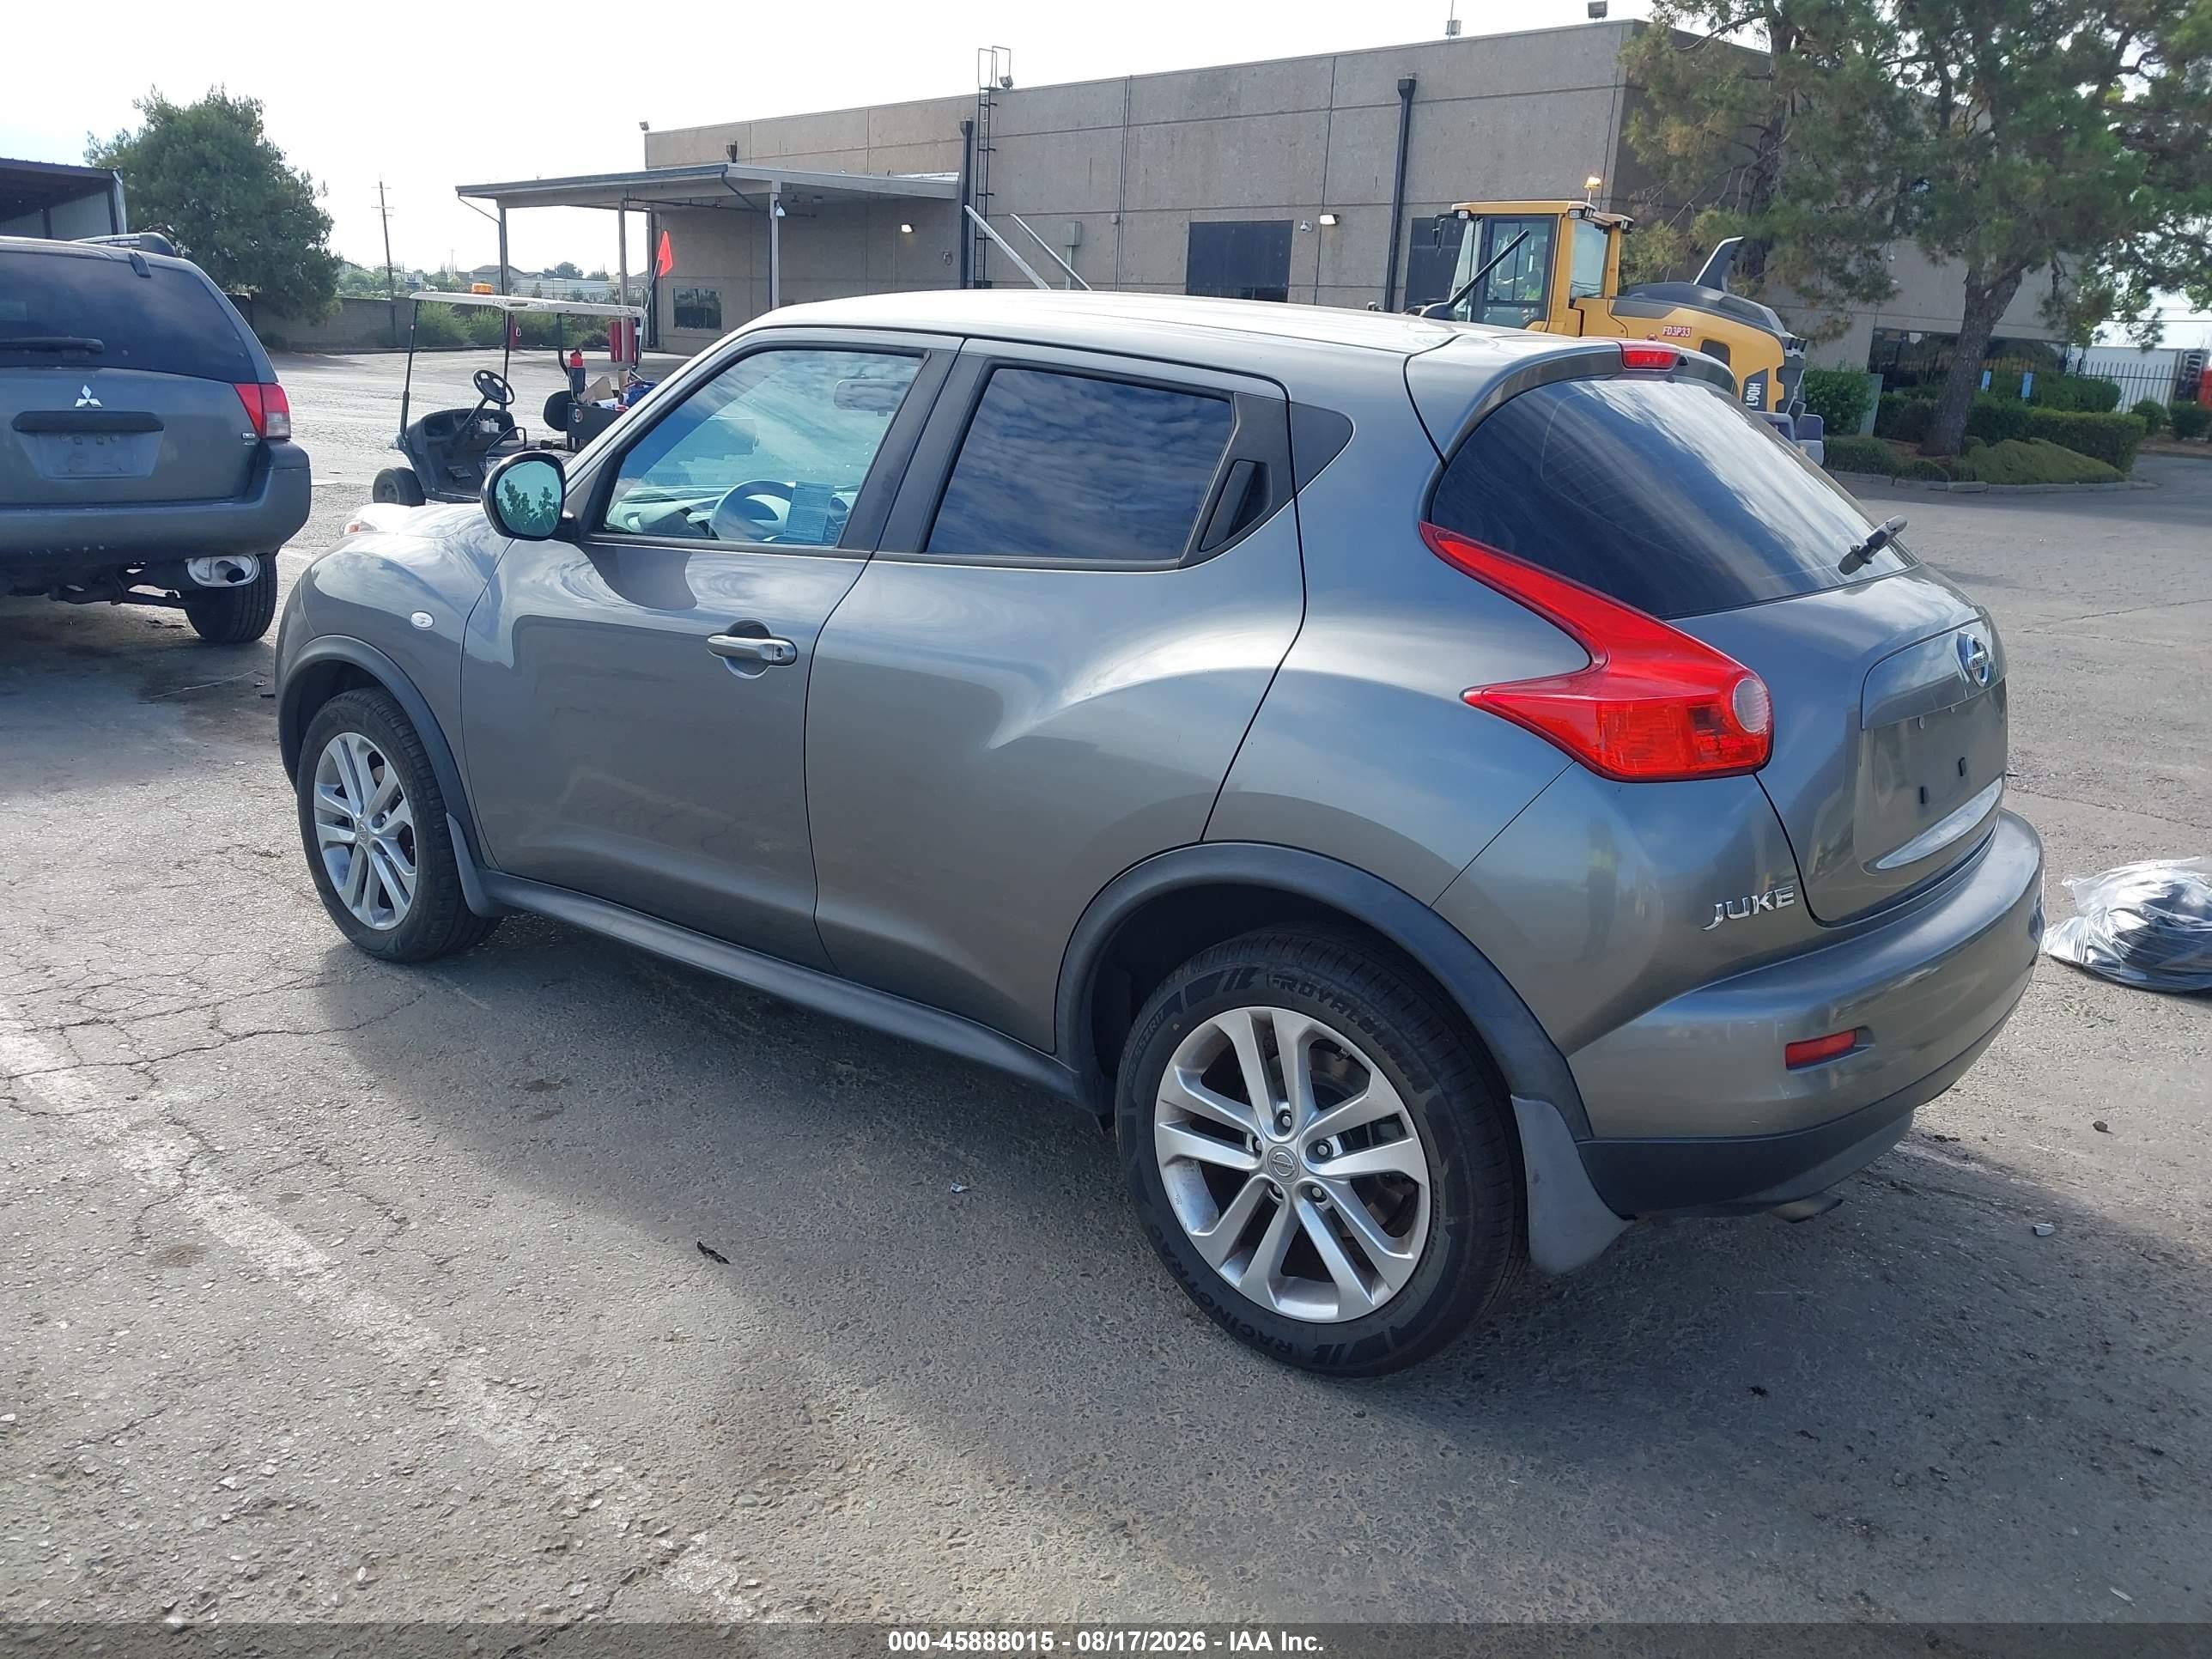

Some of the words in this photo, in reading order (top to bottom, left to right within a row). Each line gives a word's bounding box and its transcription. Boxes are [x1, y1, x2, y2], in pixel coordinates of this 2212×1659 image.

[1662, 325, 1691, 337] FD3P33
[1746, 382, 1762, 406] L90H
[1701, 885, 1795, 931] JUKE
[1271, 971, 1427, 1094] ROYALBLA
